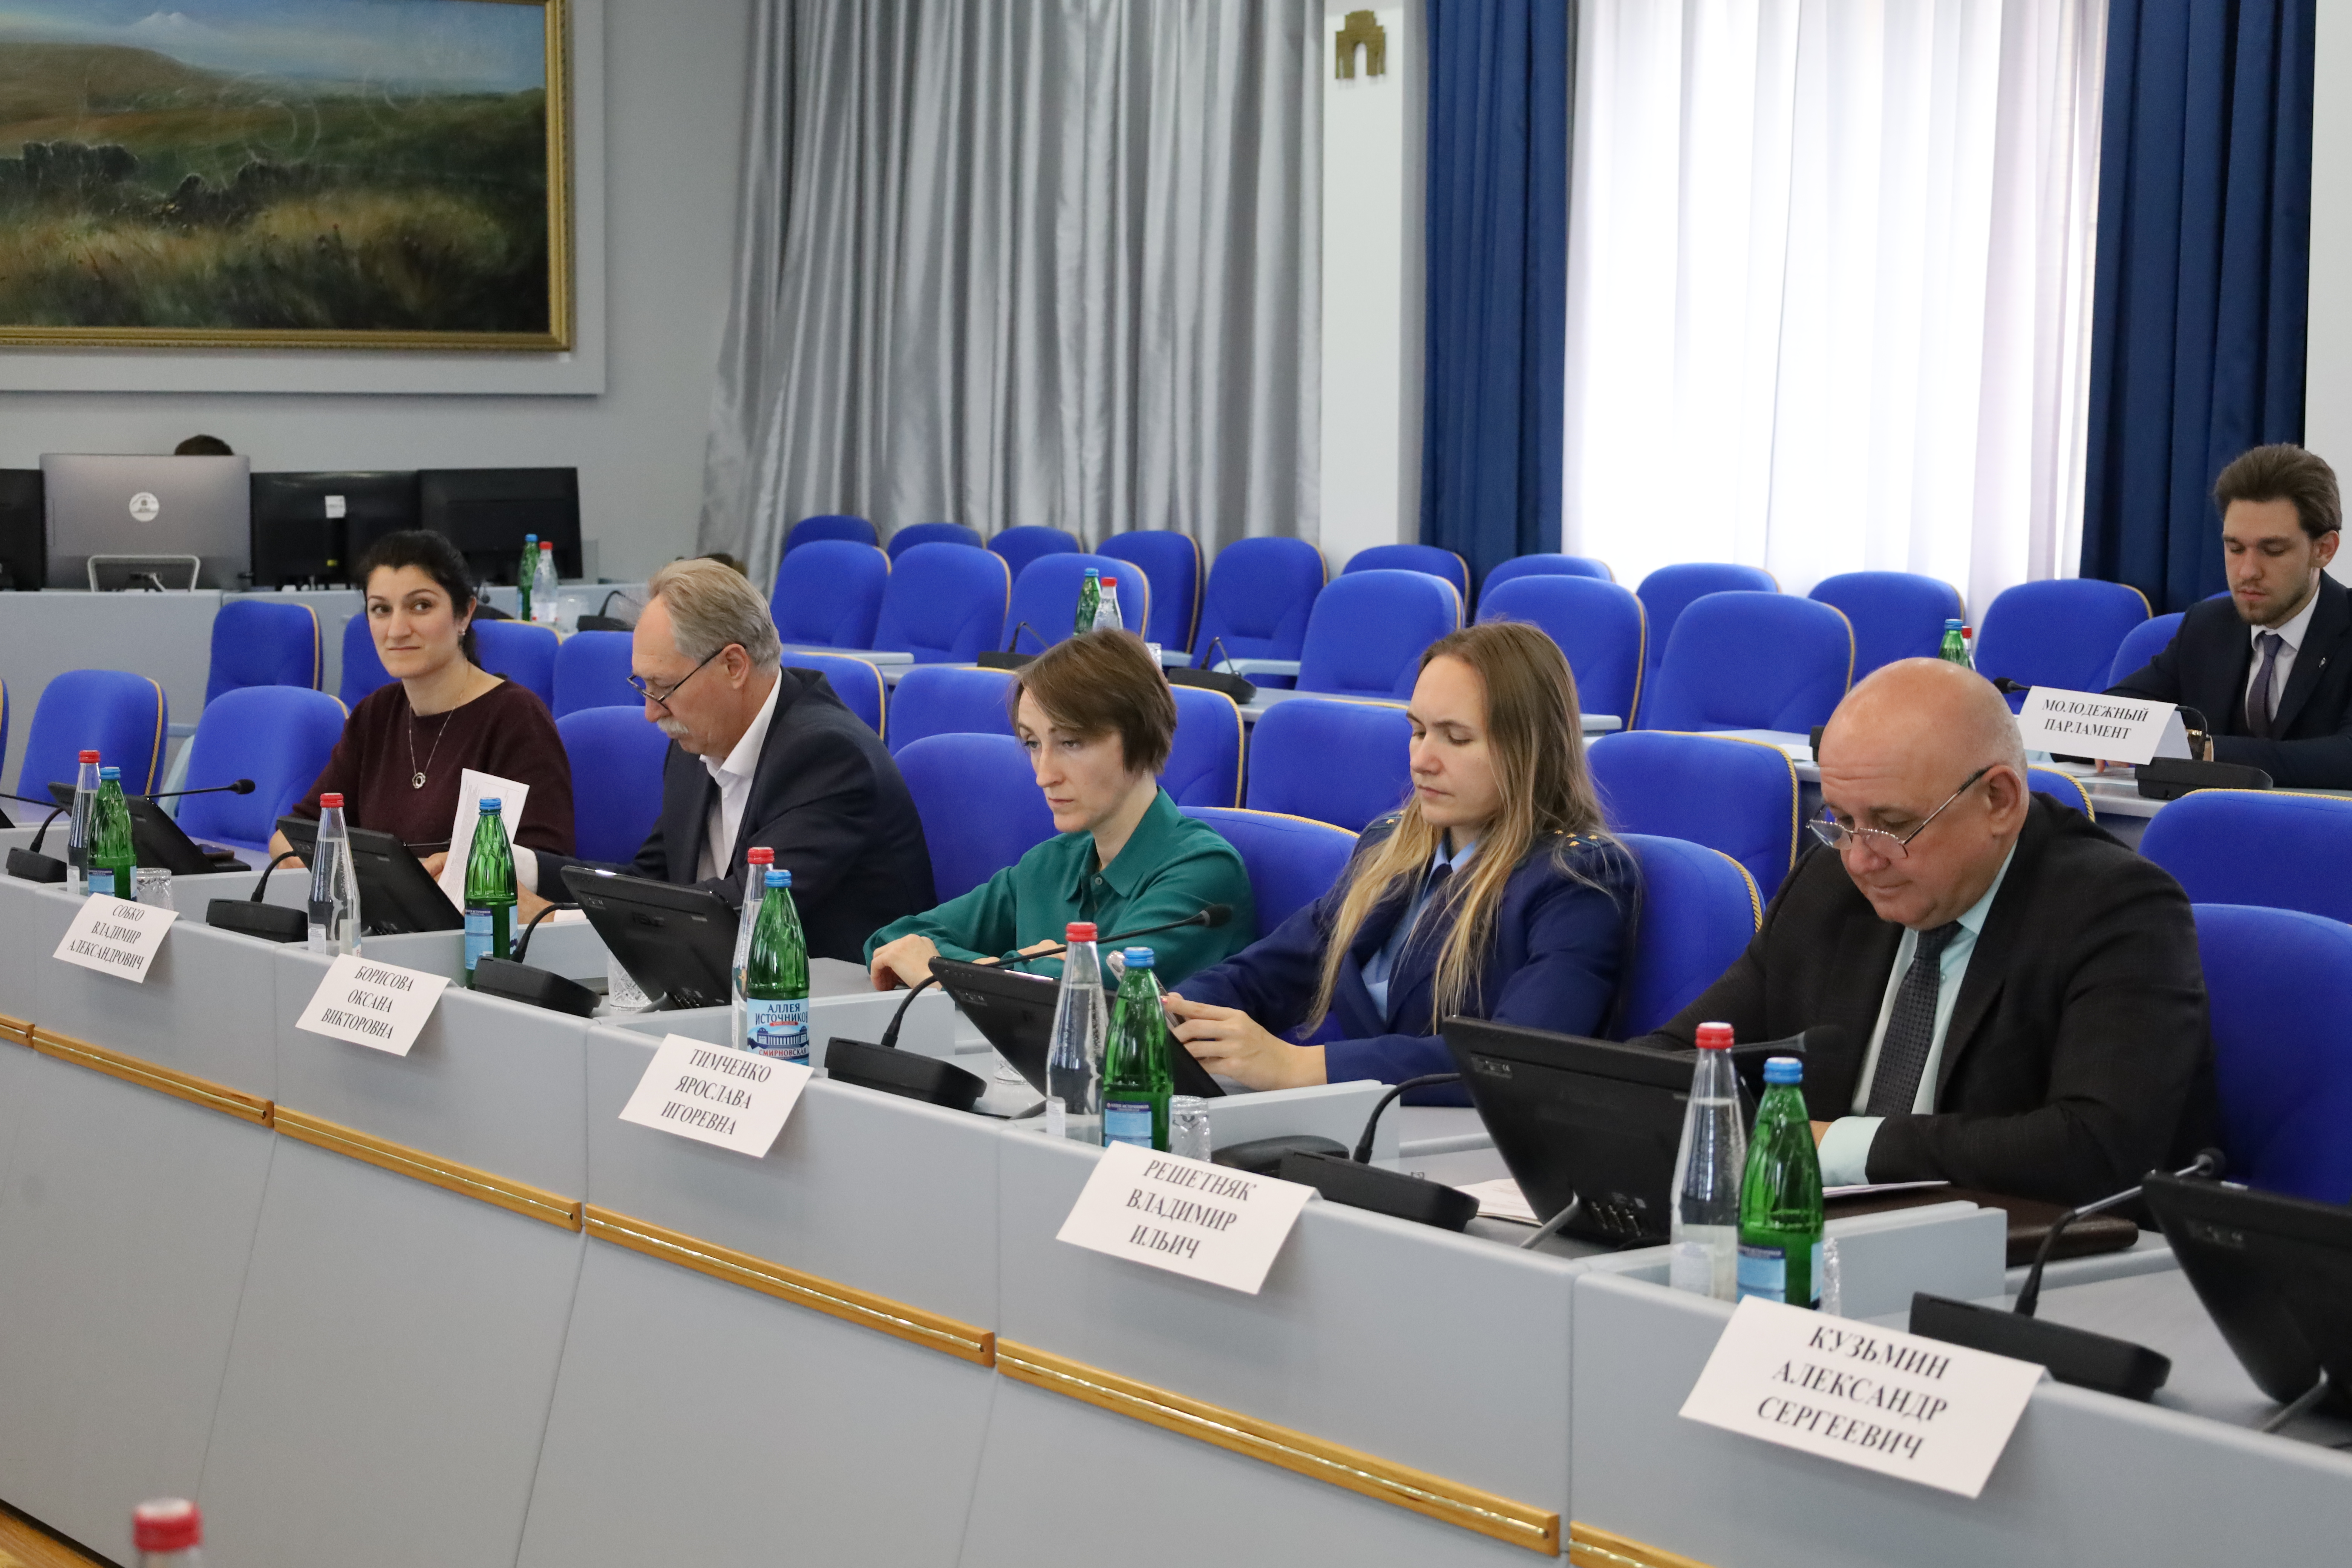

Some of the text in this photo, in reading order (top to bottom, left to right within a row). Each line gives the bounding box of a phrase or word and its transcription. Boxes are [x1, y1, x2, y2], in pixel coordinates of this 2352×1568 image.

[2042, 699, 2148, 722] МОЛОДЕЖНЫЙ
[2044, 718, 2132, 739] ПАРЛАМЕНТ
[112, 905, 145, 921] СОБКО
[91, 921, 141, 944] ВЛАДИМИР
[67, 940, 144, 969] АЛЕКСАНДРОВИЧ
[354, 966, 414, 991] БОРИСОВА
[348, 989, 393, 1013] ОКСАНА
[768, 1003, 800, 1013] АЛЛЕЯ
[321, 1008, 394, 1039] ВИКТОРОВНА
[689, 1049, 771, 1083] ТИМЧЕНКО
[759, 1048, 806, 1057] СМИРНОВСКАЯ
[675, 1076, 752, 1109] ЯРОСЛАВА
[661, 1101, 736, 1135] ИГОРЕВНА
[1143, 1160, 1257, 1201] РЕШЕТНЯК
[1126, 1189, 1237, 1231] ВЛАДИМИР
[1129, 1225, 1200, 1259] ИЛЬИЧ
[1809, 1326, 1950, 1379] КУЗЬМИН
[1773, 1361, 1947, 1421] АЛЕКСАНДР
[1758, 1398, 1923, 1459] СЕРГЕЕВИЧ
